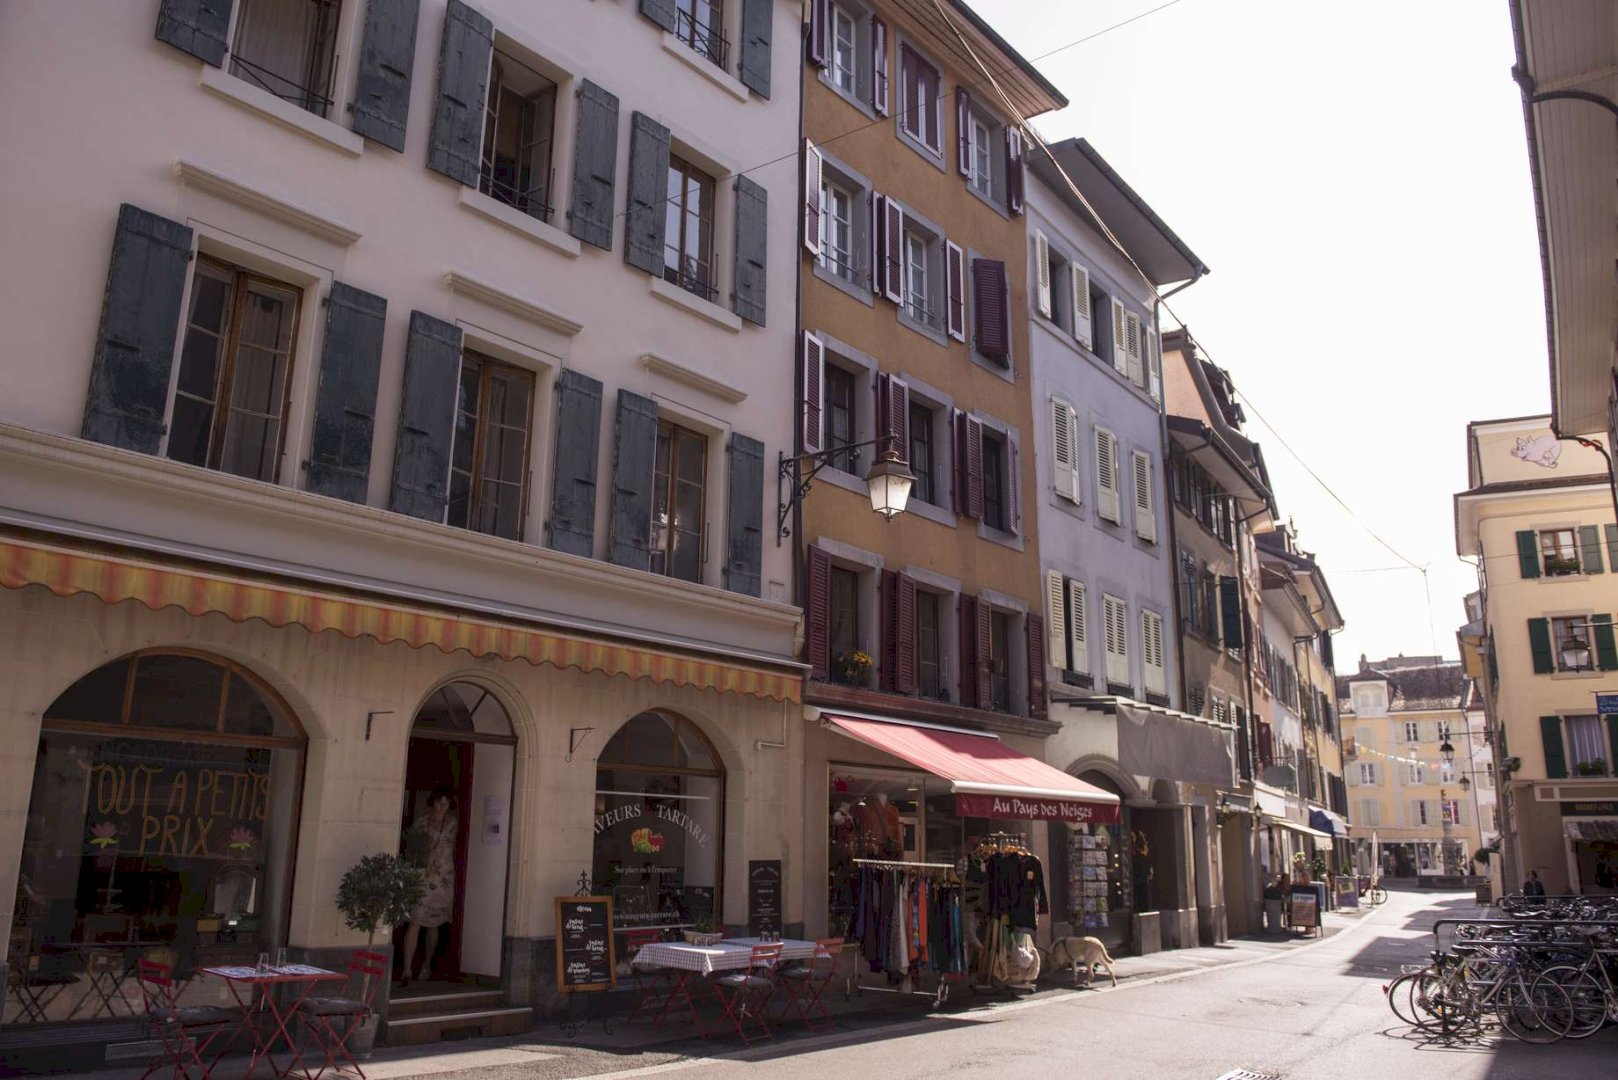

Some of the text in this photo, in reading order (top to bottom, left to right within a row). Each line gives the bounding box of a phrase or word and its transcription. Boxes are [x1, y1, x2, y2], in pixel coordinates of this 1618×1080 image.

[78, 759, 270, 821] TOUT A PETITS
[992, 798, 1093, 821] Au Pays des Neiges
[139, 815, 214, 859] PRIX
[656, 804, 710, 848] TARTARE
